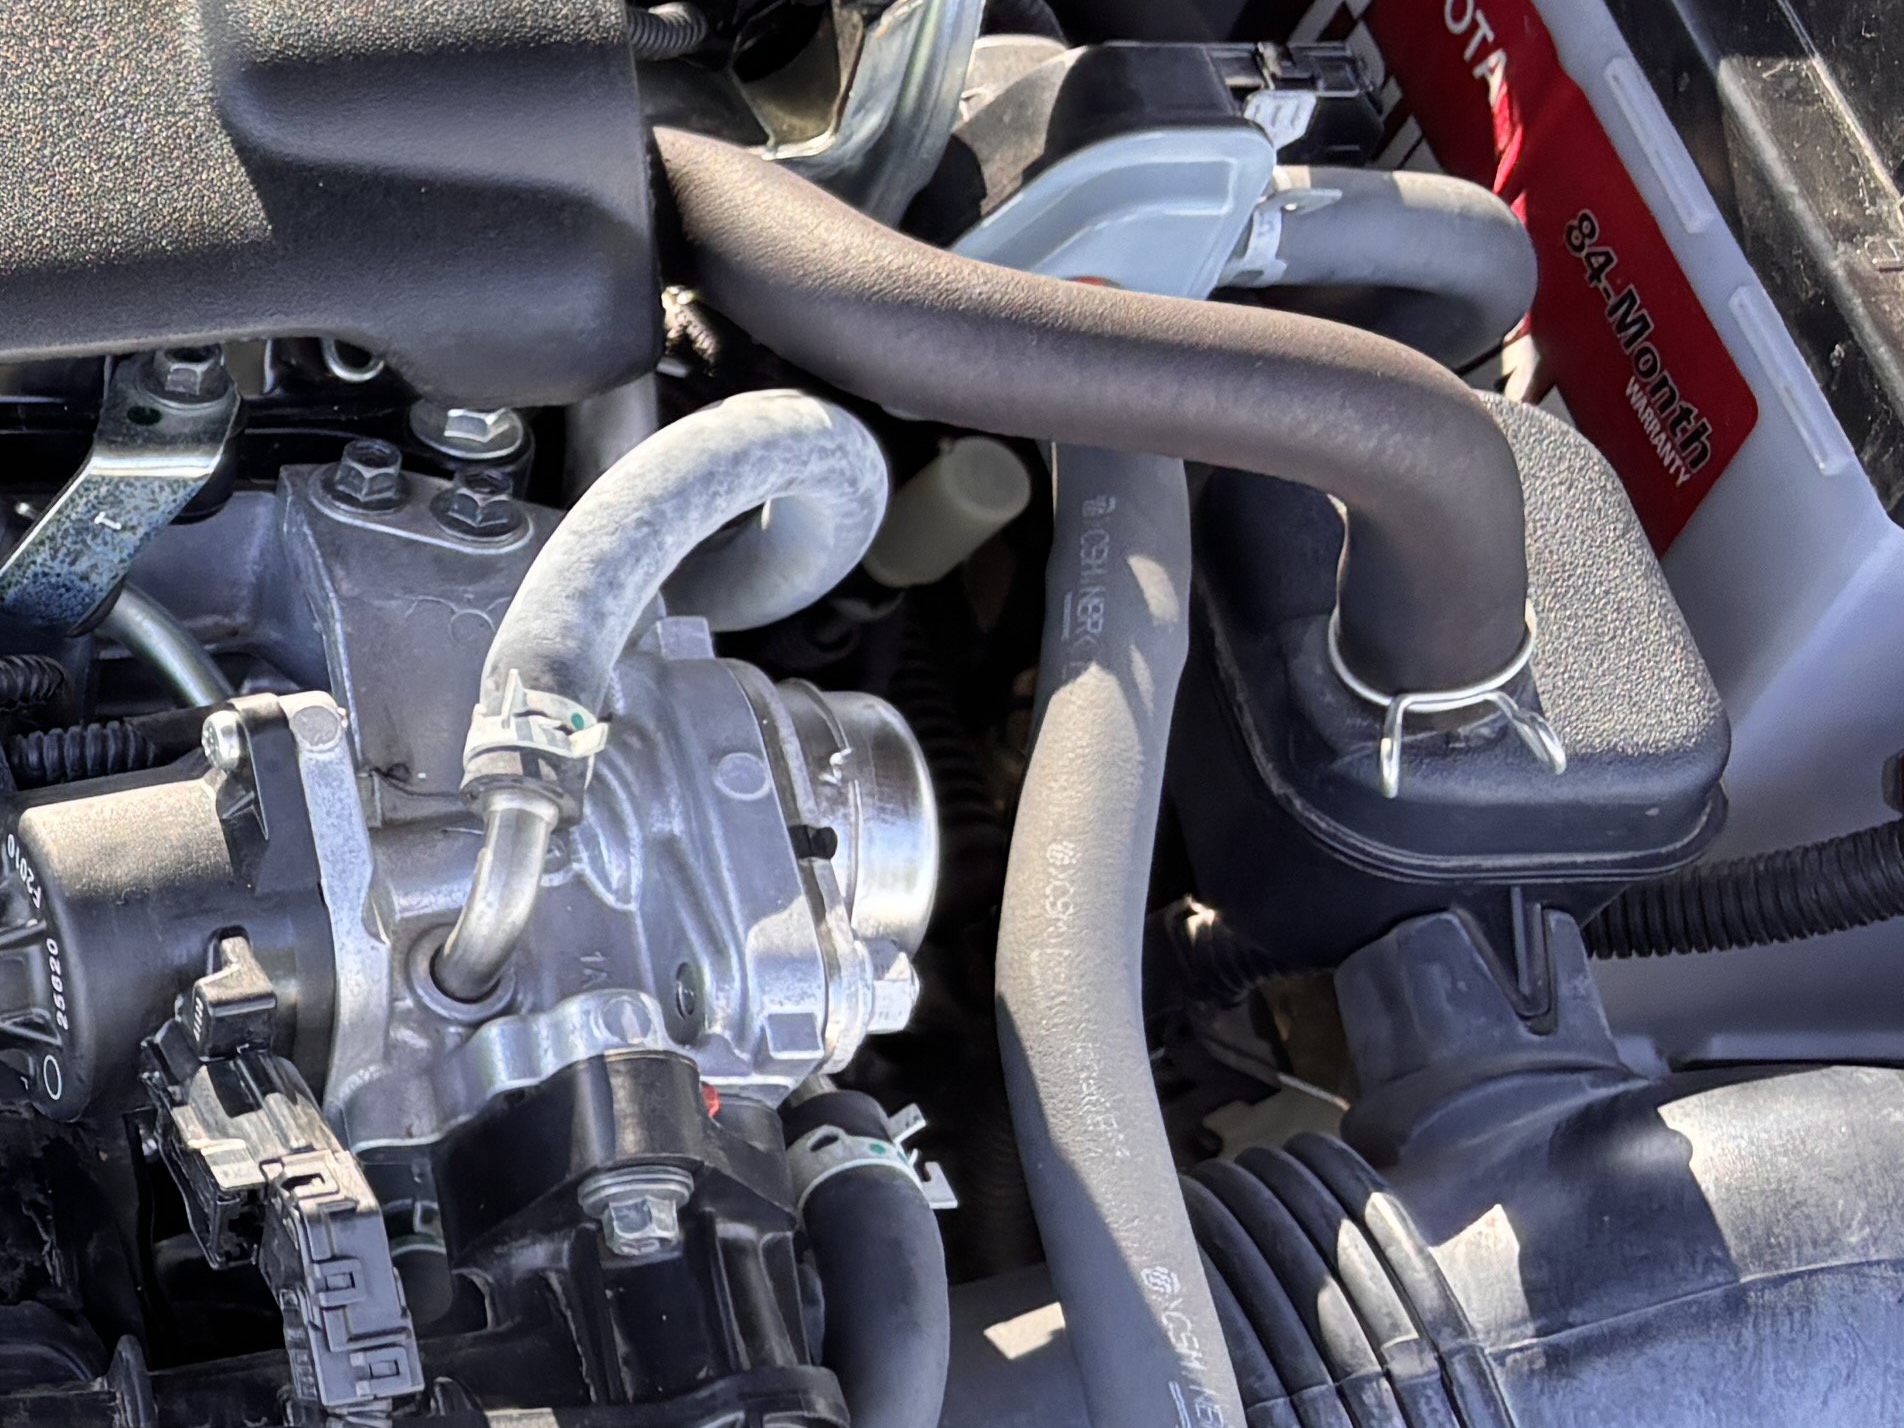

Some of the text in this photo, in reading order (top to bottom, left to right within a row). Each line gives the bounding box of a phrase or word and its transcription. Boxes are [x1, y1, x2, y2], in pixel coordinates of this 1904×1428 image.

[1557, 207, 1726, 469] 84-Month
[1618, 376, 1693, 485] WARRANTY
[4, 833, 68, 1029] 25620 F2010
